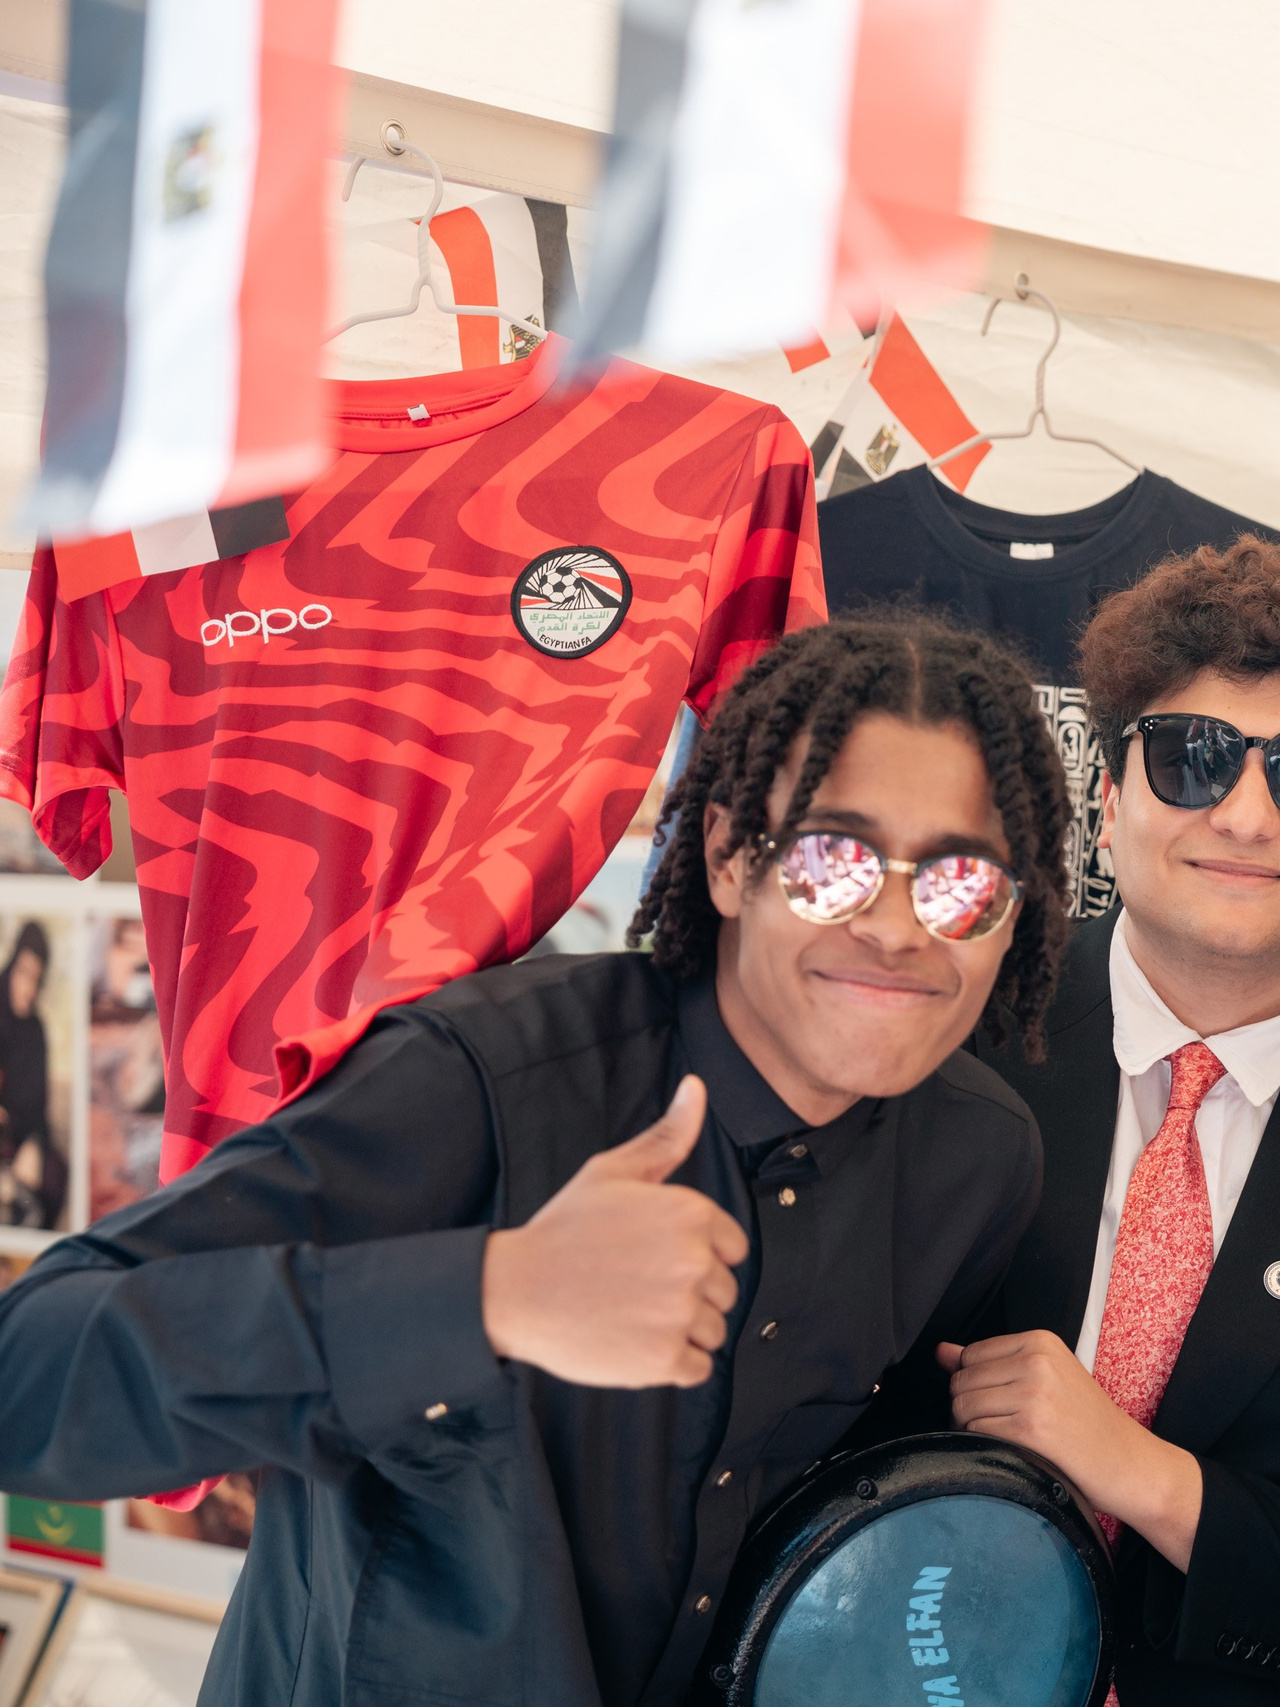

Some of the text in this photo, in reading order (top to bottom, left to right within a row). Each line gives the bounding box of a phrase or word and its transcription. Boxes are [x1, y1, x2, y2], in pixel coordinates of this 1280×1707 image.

[201, 604, 332, 647] oppo
[539, 634, 580, 649] EGYPTIAN
[906, 1566, 952, 1666] ELFAN
